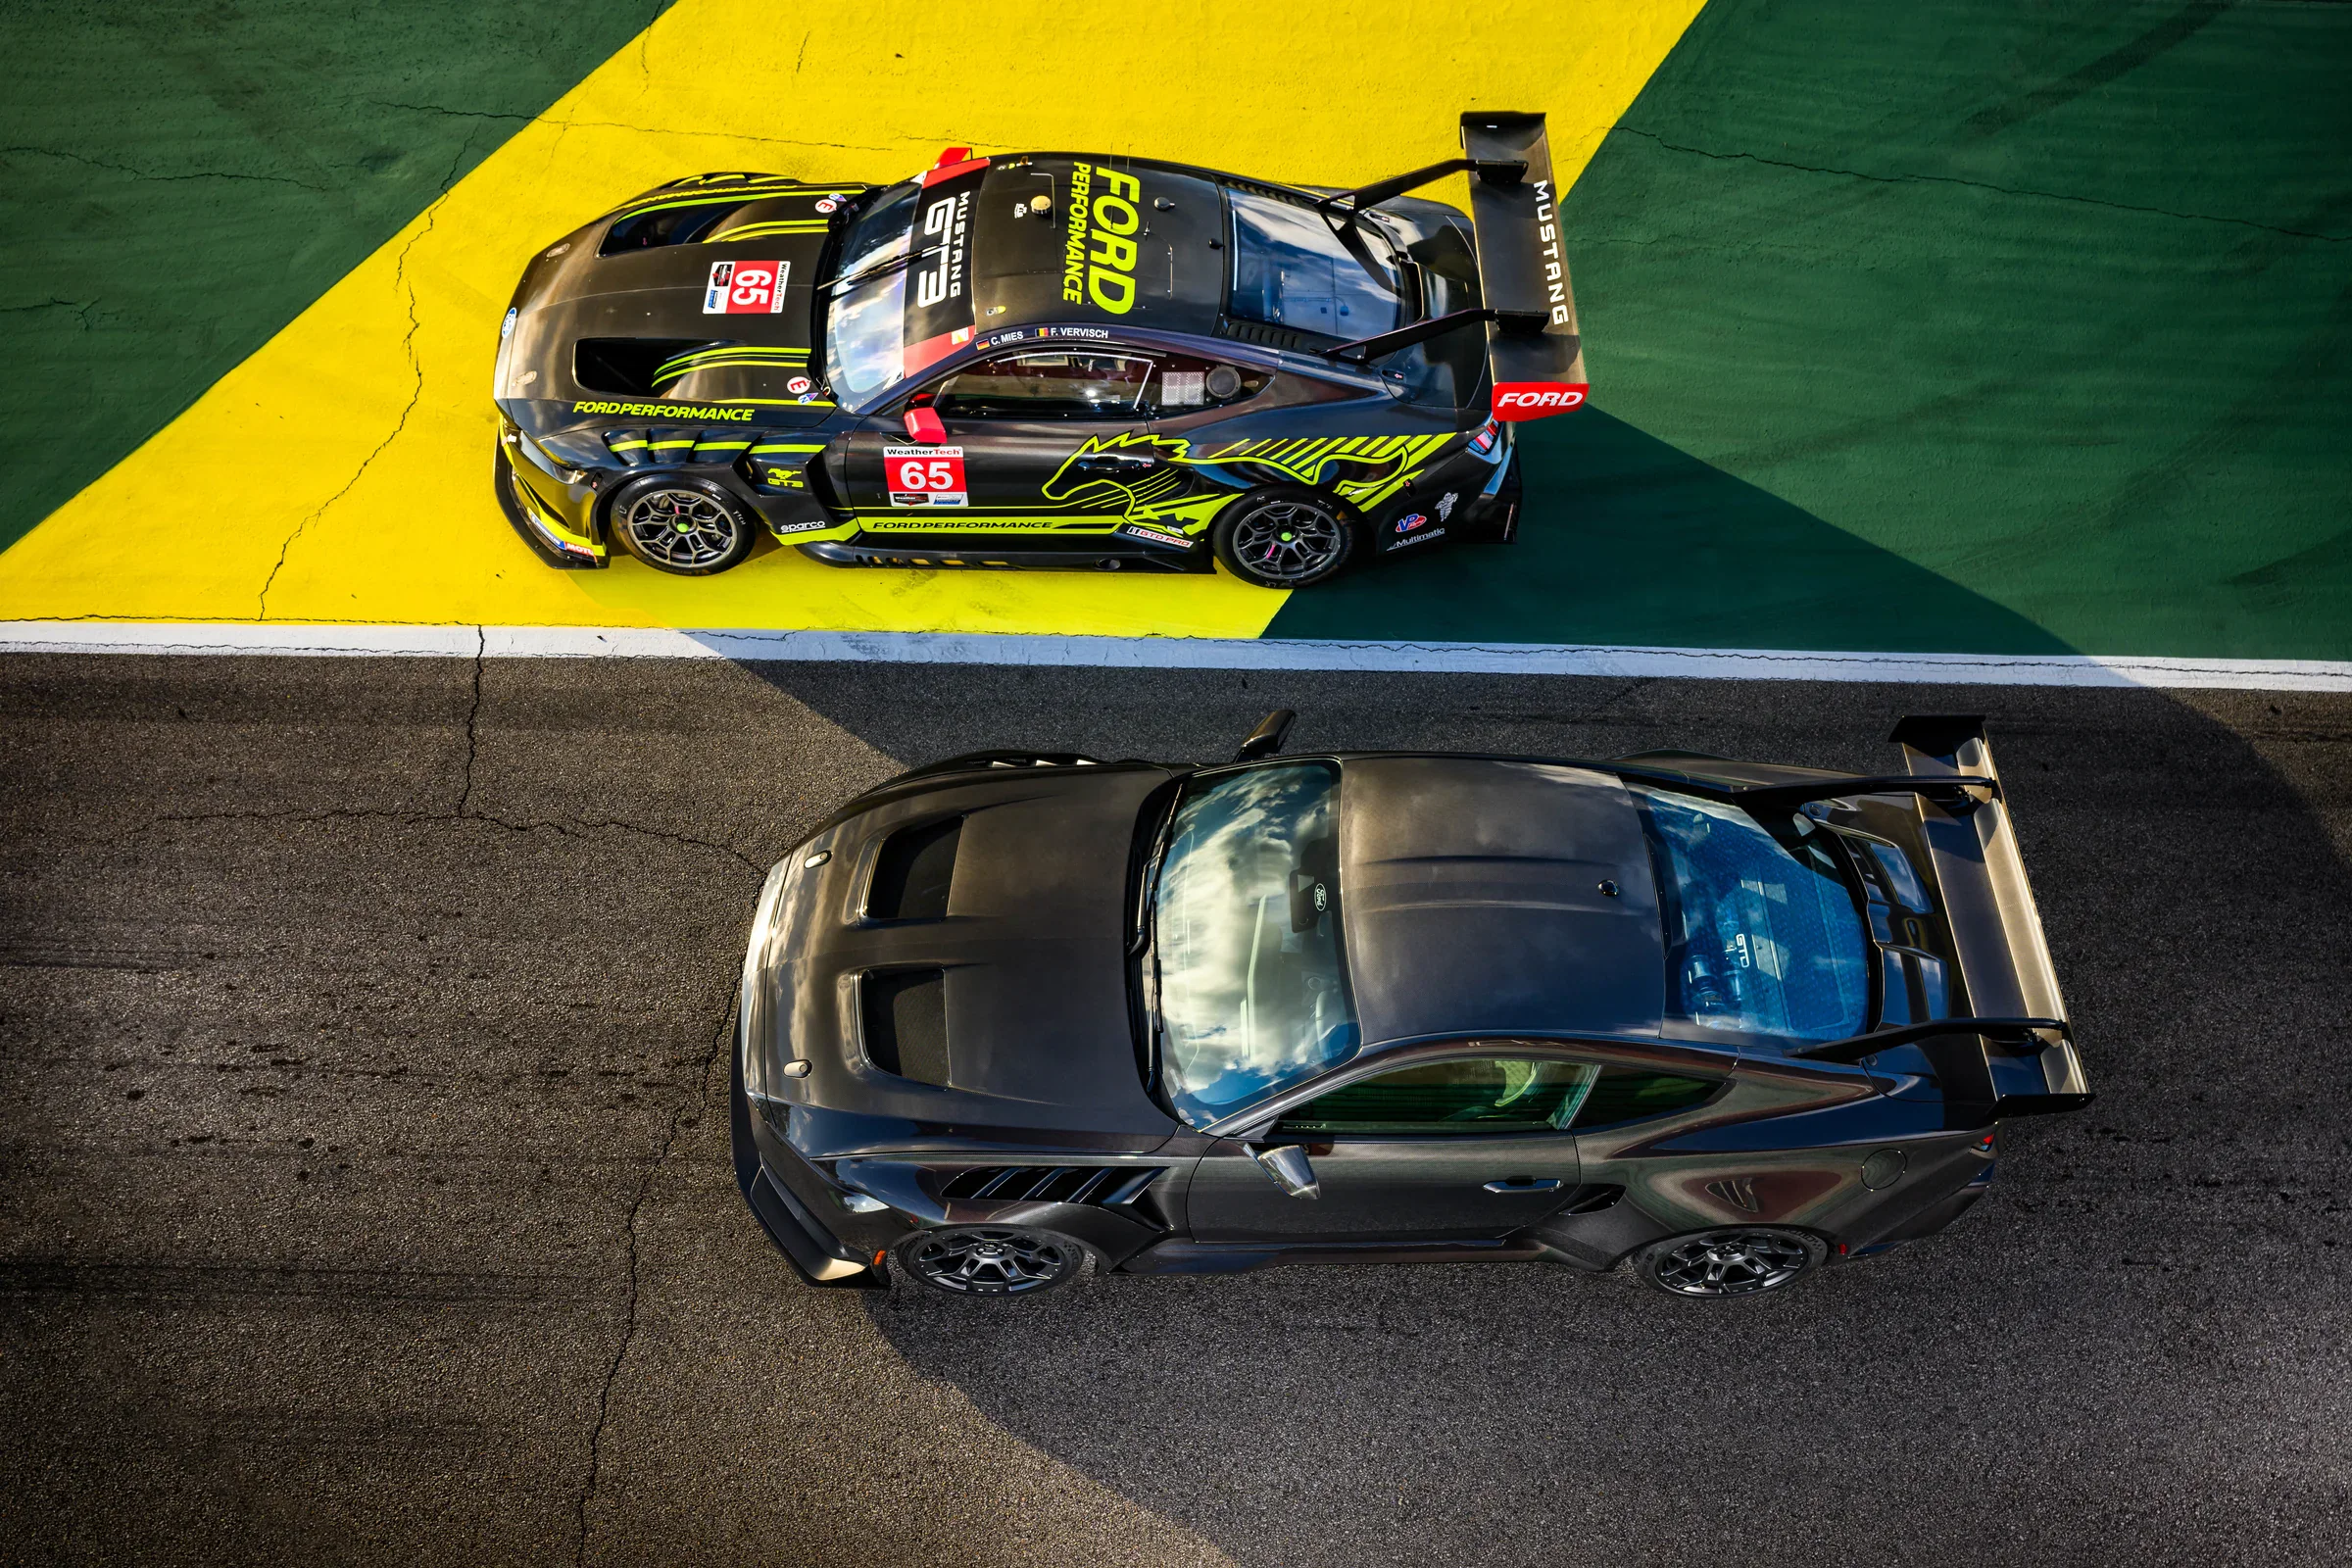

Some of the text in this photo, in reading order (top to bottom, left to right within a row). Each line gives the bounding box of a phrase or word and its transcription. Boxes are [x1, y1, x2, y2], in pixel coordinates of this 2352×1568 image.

[951, 191, 971, 298] MUSTANG
[1063, 162, 1092, 305] PERFORMANCE
[1089, 167, 1141, 315] FORD
[917, 197, 956, 308] GT3
[1533, 179, 1569, 325] MUSTANG
[731, 270, 772, 306] 65
[773, 263, 788, 312] WeatherTech
[991, 331, 1024, 345] C. MIES
[1051, 327, 1108, 339] F. VERVISCH
[1496, 392, 1584, 408] FORD
[900, 461, 954, 490] 65
[1140, 530, 1163, 540] GTD
[1165, 537, 1190, 546] PRO
[1396, 527, 1446, 548] Multimatic
[1397, 513, 1420, 531] VP
[1736, 933, 1750, 968] GTD
